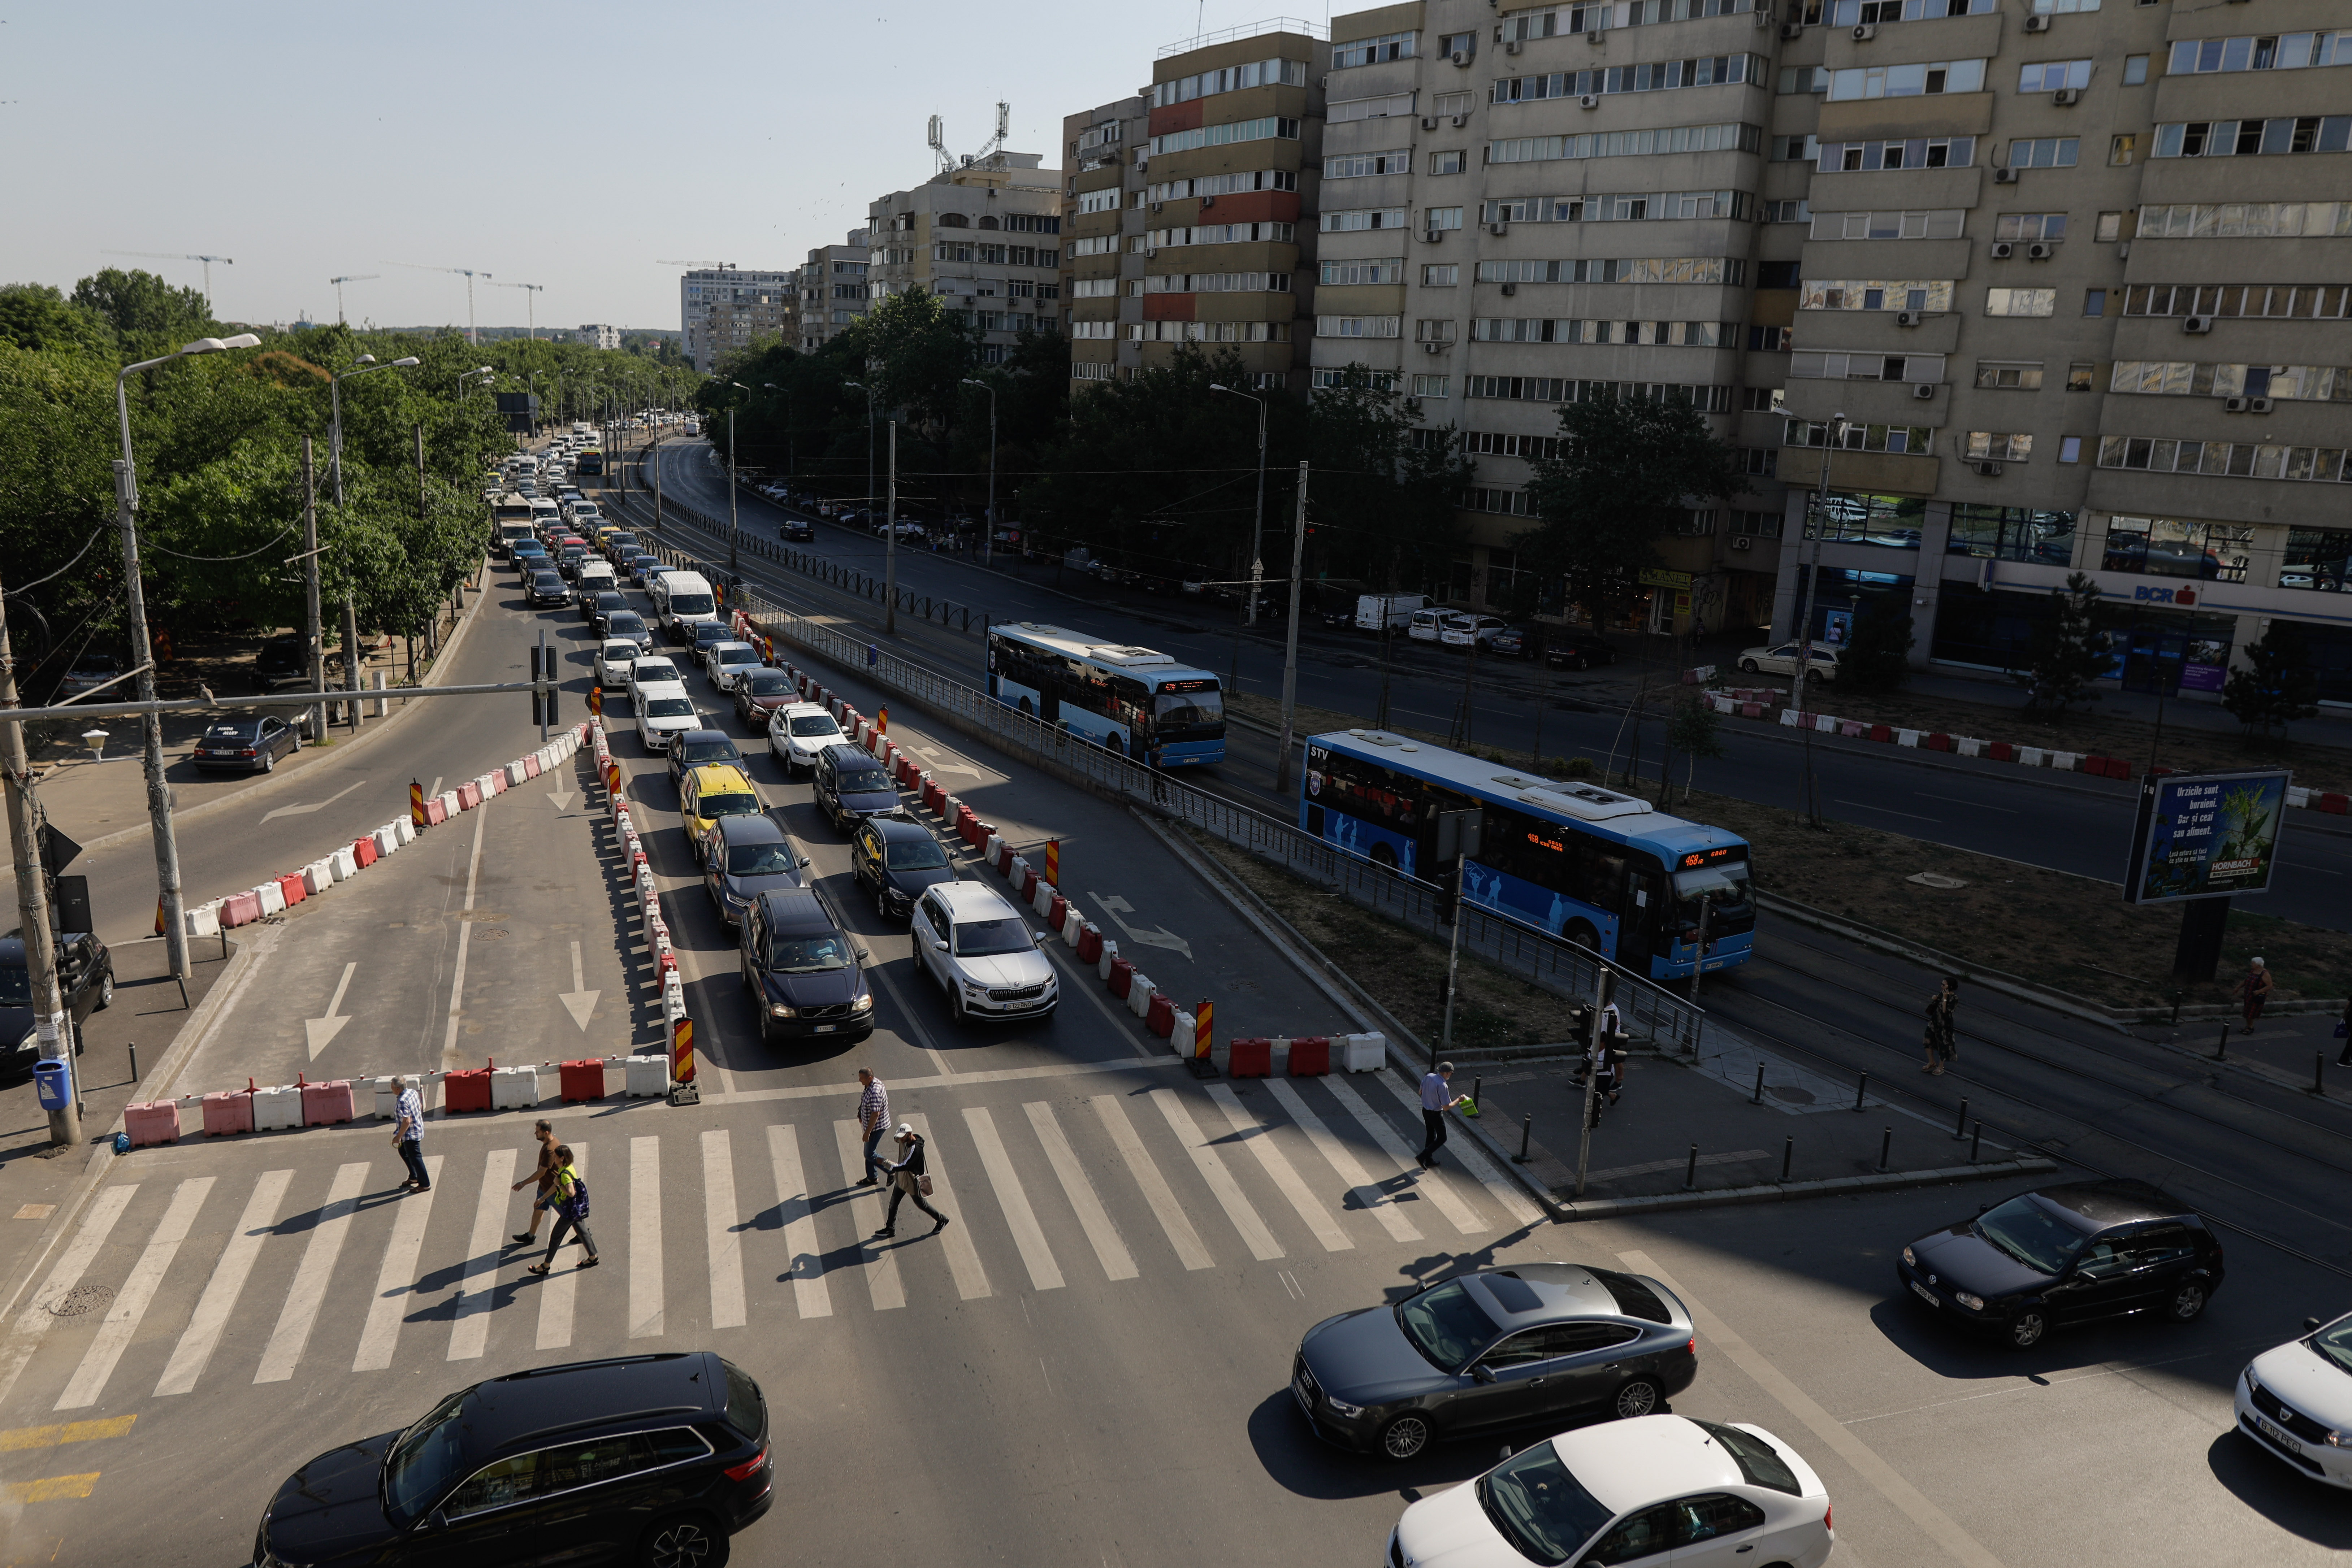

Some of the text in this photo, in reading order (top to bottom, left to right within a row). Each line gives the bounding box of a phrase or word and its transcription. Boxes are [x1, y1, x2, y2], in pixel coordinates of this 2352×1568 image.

[1641, 571, 1689, 584] AMANET
[2135, 586, 2174, 603] BCR
[990, 633, 999, 642] STV
[1311, 746, 1329, 760] STV
[2177, 785, 2219, 797] Urzicile sunt
[2189, 798, 2217, 809] buruieni.
[2177, 815, 2189, 824] Dar
[2200, 812, 2214, 822] ceai
[1528, 833, 1538, 843] 468
[2173, 826, 2212, 838] sau aliment.
[1685, 854, 1699, 866] 468
[2212, 859, 2252, 871] HORNBACH
[237, 898, 251, 906] VESTA
[199, 911, 212, 919] VESTA
[1918, 1287, 1927, 1296] 888
[1927, 1293, 1939, 1305] VFY
[2269, 1428, 2279, 1439] 112
[2281, 1435, 2297, 1450] PEC
